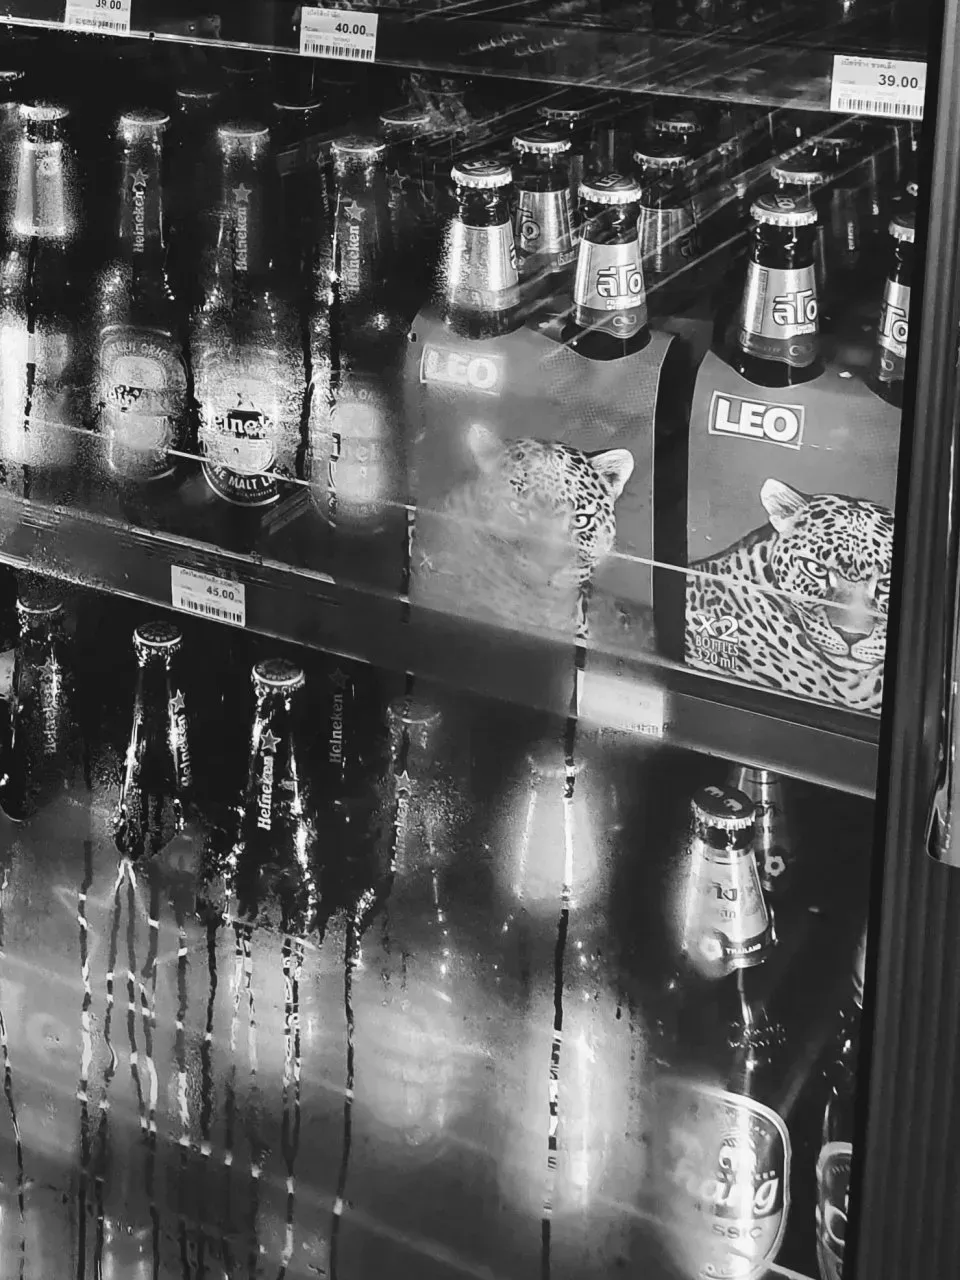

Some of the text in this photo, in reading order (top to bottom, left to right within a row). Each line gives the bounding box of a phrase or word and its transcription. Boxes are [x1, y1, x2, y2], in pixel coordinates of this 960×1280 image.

[335, 21, 368, 36] 40.00
[878, 74, 919, 89] 39.00
[715, 397, 800, 443] LEO
[227, 474, 258, 491] MALT
[206, 585, 235, 601] 45.00
[694, 634, 739, 657] BOTTLES
[694, 649, 718, 666] 320
[257, 750, 275, 832] Heineken
